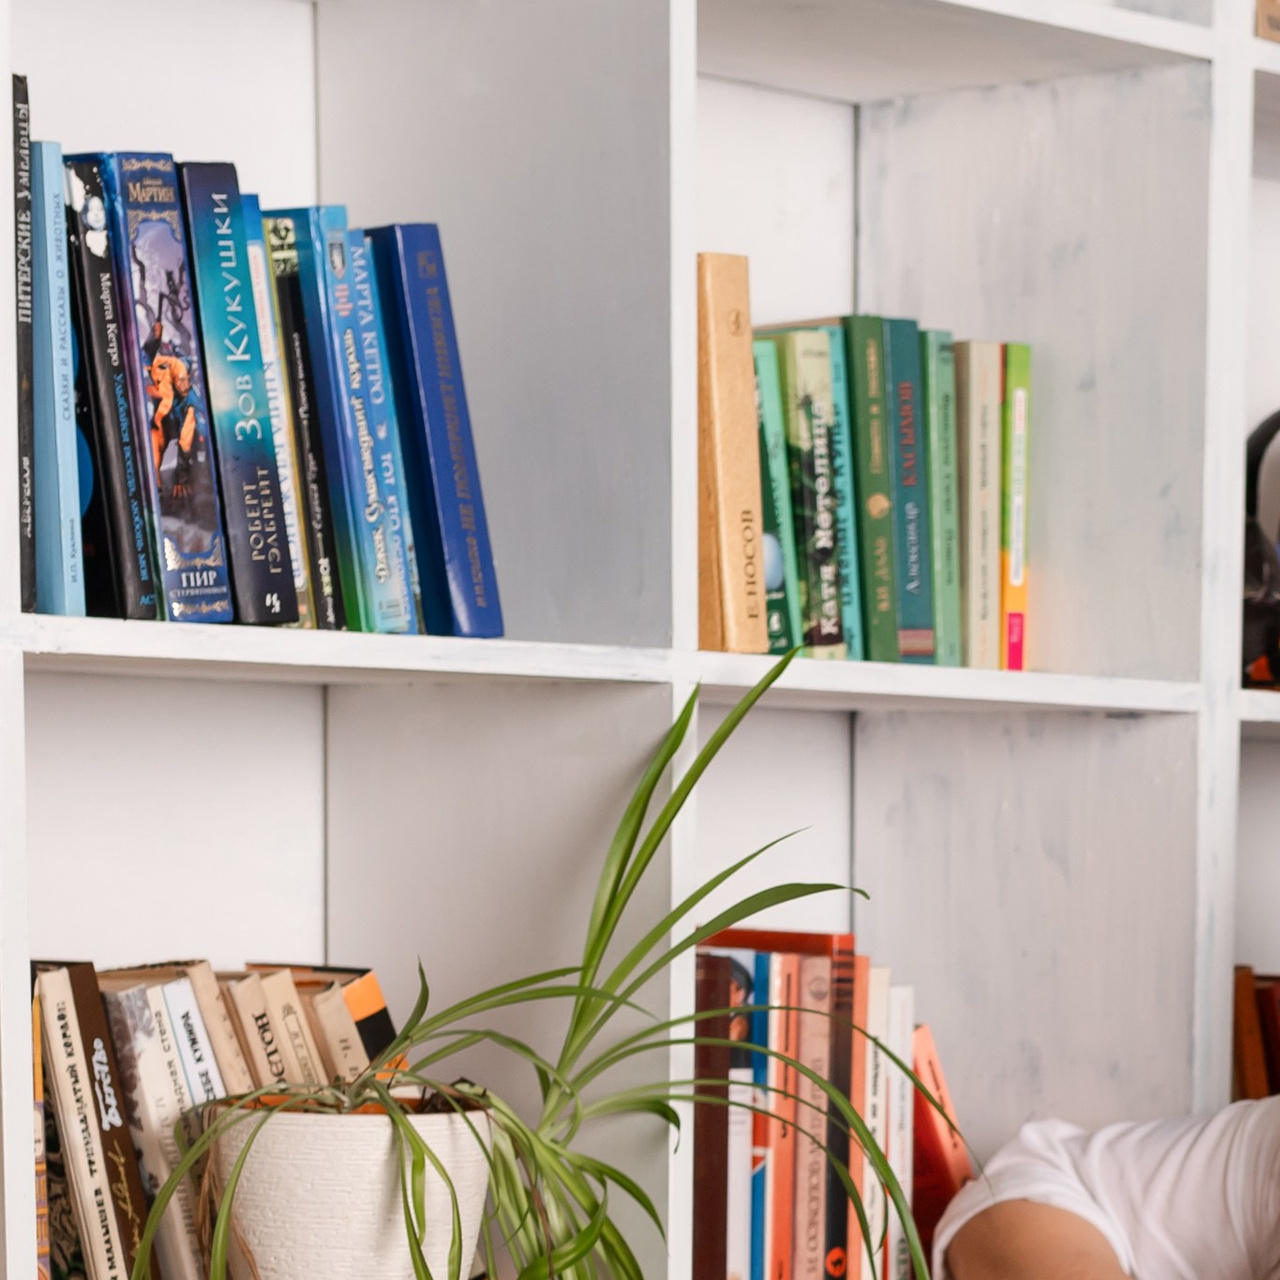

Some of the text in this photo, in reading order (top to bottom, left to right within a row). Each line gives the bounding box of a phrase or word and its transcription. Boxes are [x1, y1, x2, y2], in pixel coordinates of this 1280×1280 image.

[15, 209, 33, 323] ПИТЕРСКИЕ
[52, 192, 71, 421] СКАЗКИ И РАССКАЗЫ О ЖИВОТНЫХ
[97, 271, 122, 367] Марта Кетро
[350, 244, 385, 405] МАРТА КЕТРО
[897, 381, 917, 486] КАСЫМОВ
[242, 480, 265, 560] РОБЕРТ
[256, 464, 283, 574] ГЭЛБРЕЙТ
[740, 508, 758, 596] НОСОВ
[807, 400, 838, 634] Катя Метелица
[181, 570, 217, 588] ПИР
